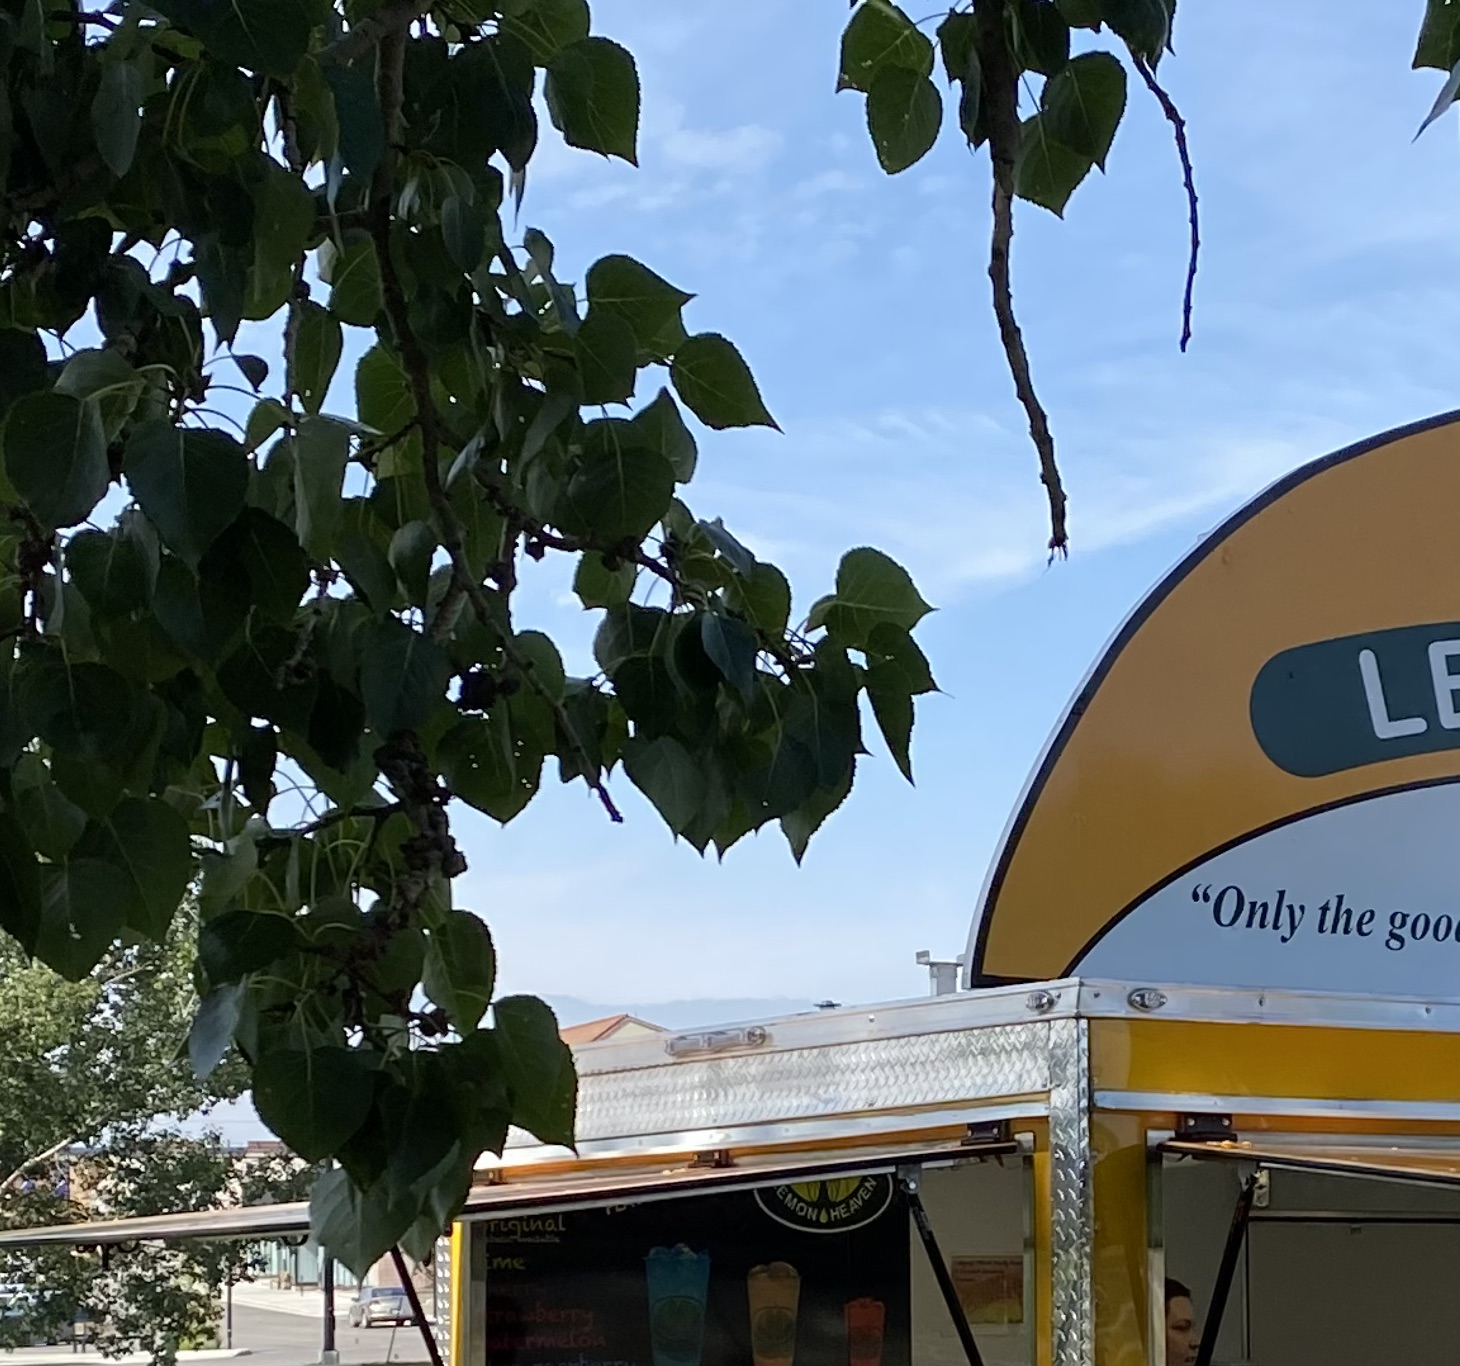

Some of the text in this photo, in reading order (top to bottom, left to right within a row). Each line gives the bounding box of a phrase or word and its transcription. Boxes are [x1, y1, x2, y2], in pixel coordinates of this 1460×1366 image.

[1191, 883, 1305, 944] “Only
[1317, 894, 1376, 937] the
[775, 1176, 878, 1222] EMON HEAVEN
[488, 1213, 566, 1238] riginal
